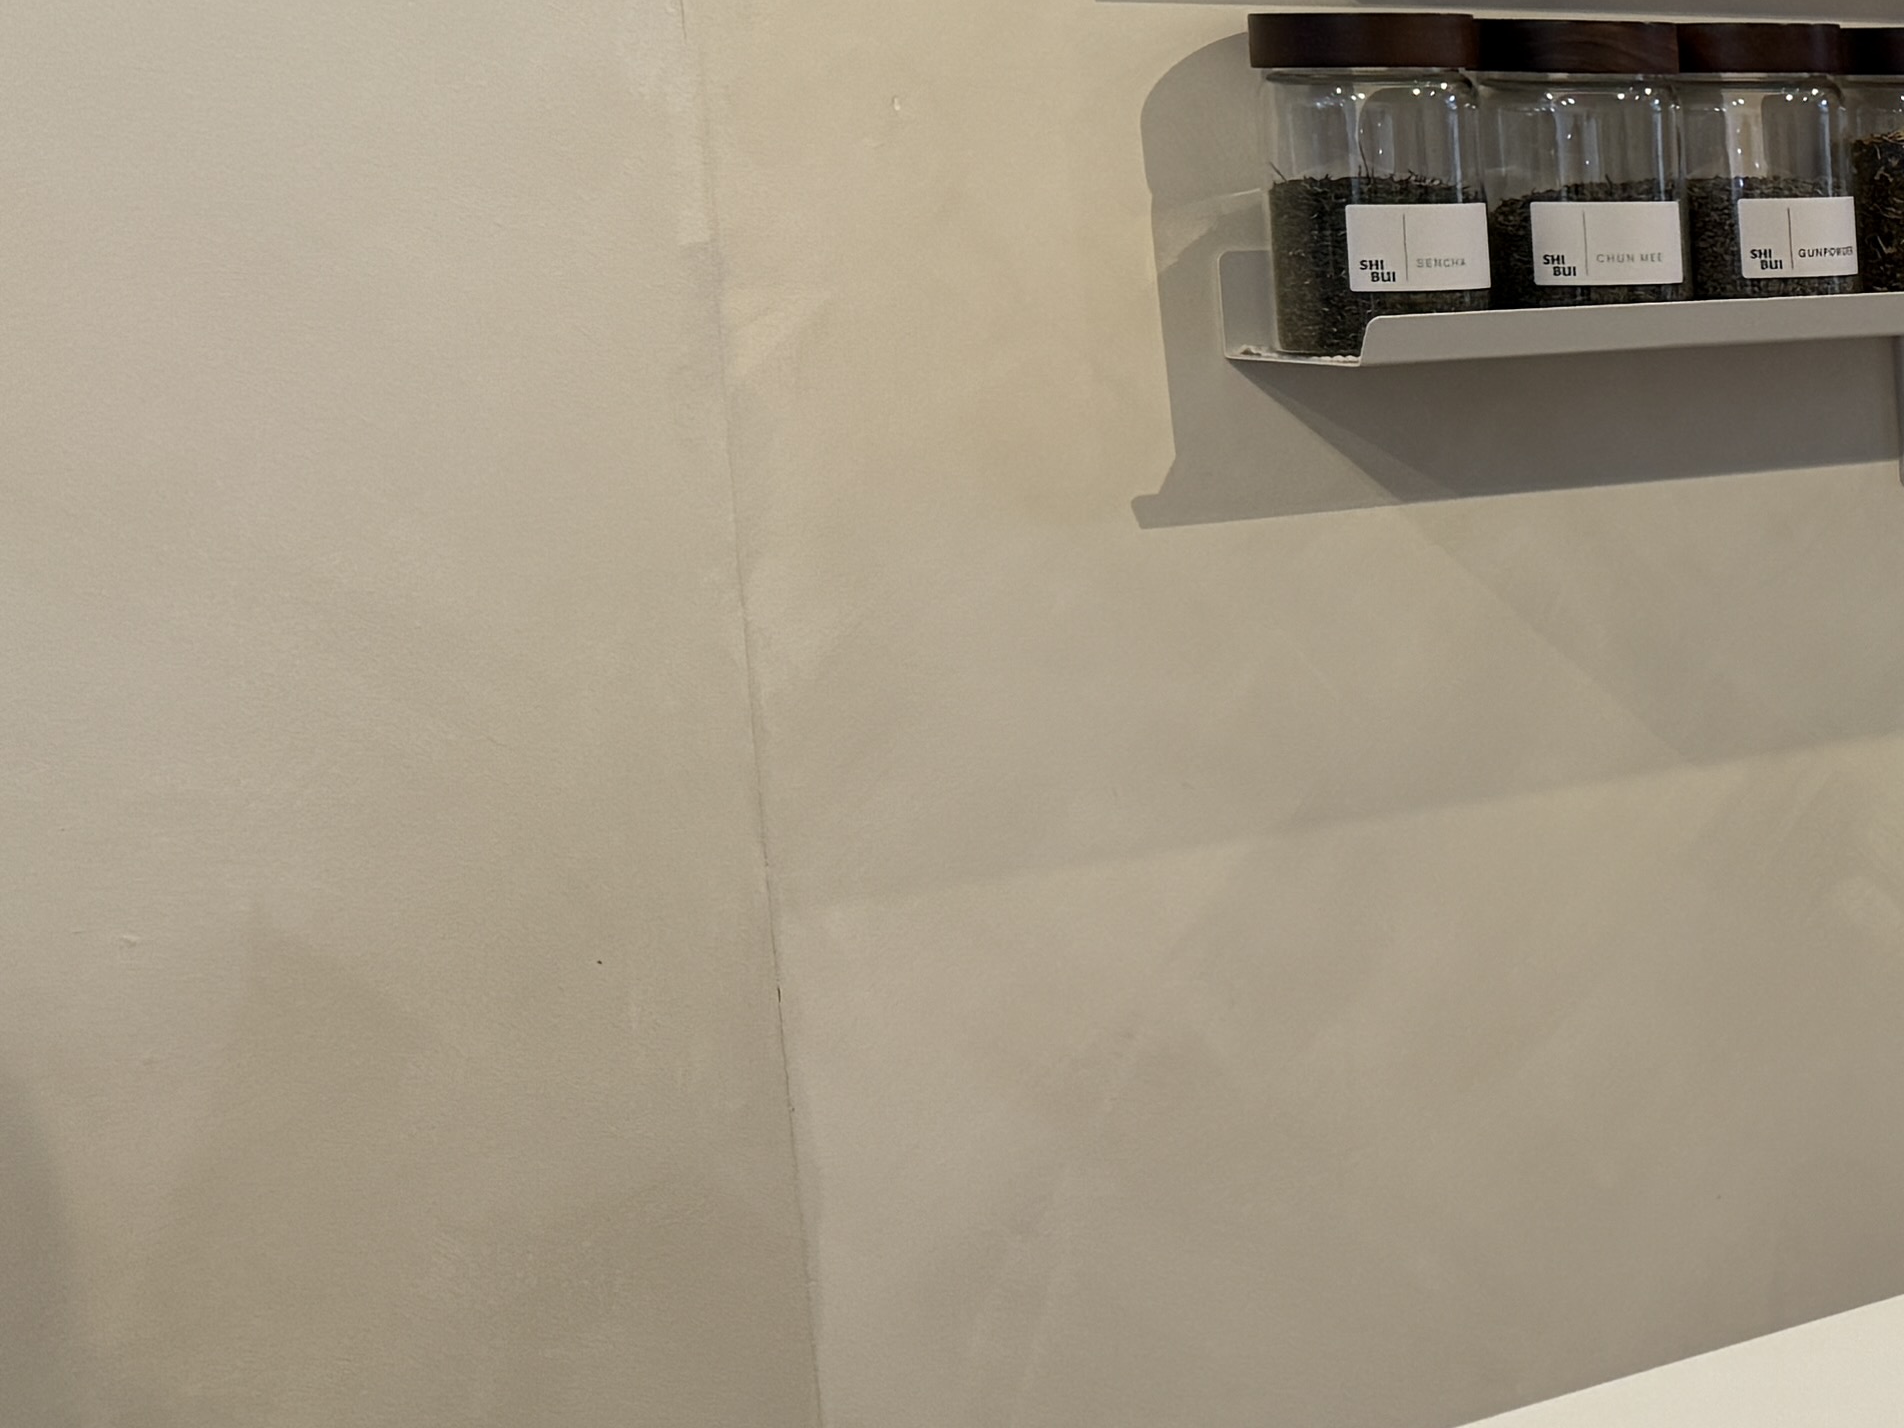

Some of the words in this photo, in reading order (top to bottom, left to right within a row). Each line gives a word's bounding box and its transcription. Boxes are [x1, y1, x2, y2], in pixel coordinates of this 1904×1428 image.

[1596, 253, 1635, 263] CHUN
[1749, 248, 1772, 259] SHI
[1359, 259, 1384, 271] SHI
[1416, 257, 1466, 268] SENCHA
[1542, 254, 1565, 265] SHI
[1760, 259, 1783, 270] BUI
[1370, 271, 1396, 282] BUI
[1552, 266, 1577, 277] BUI
